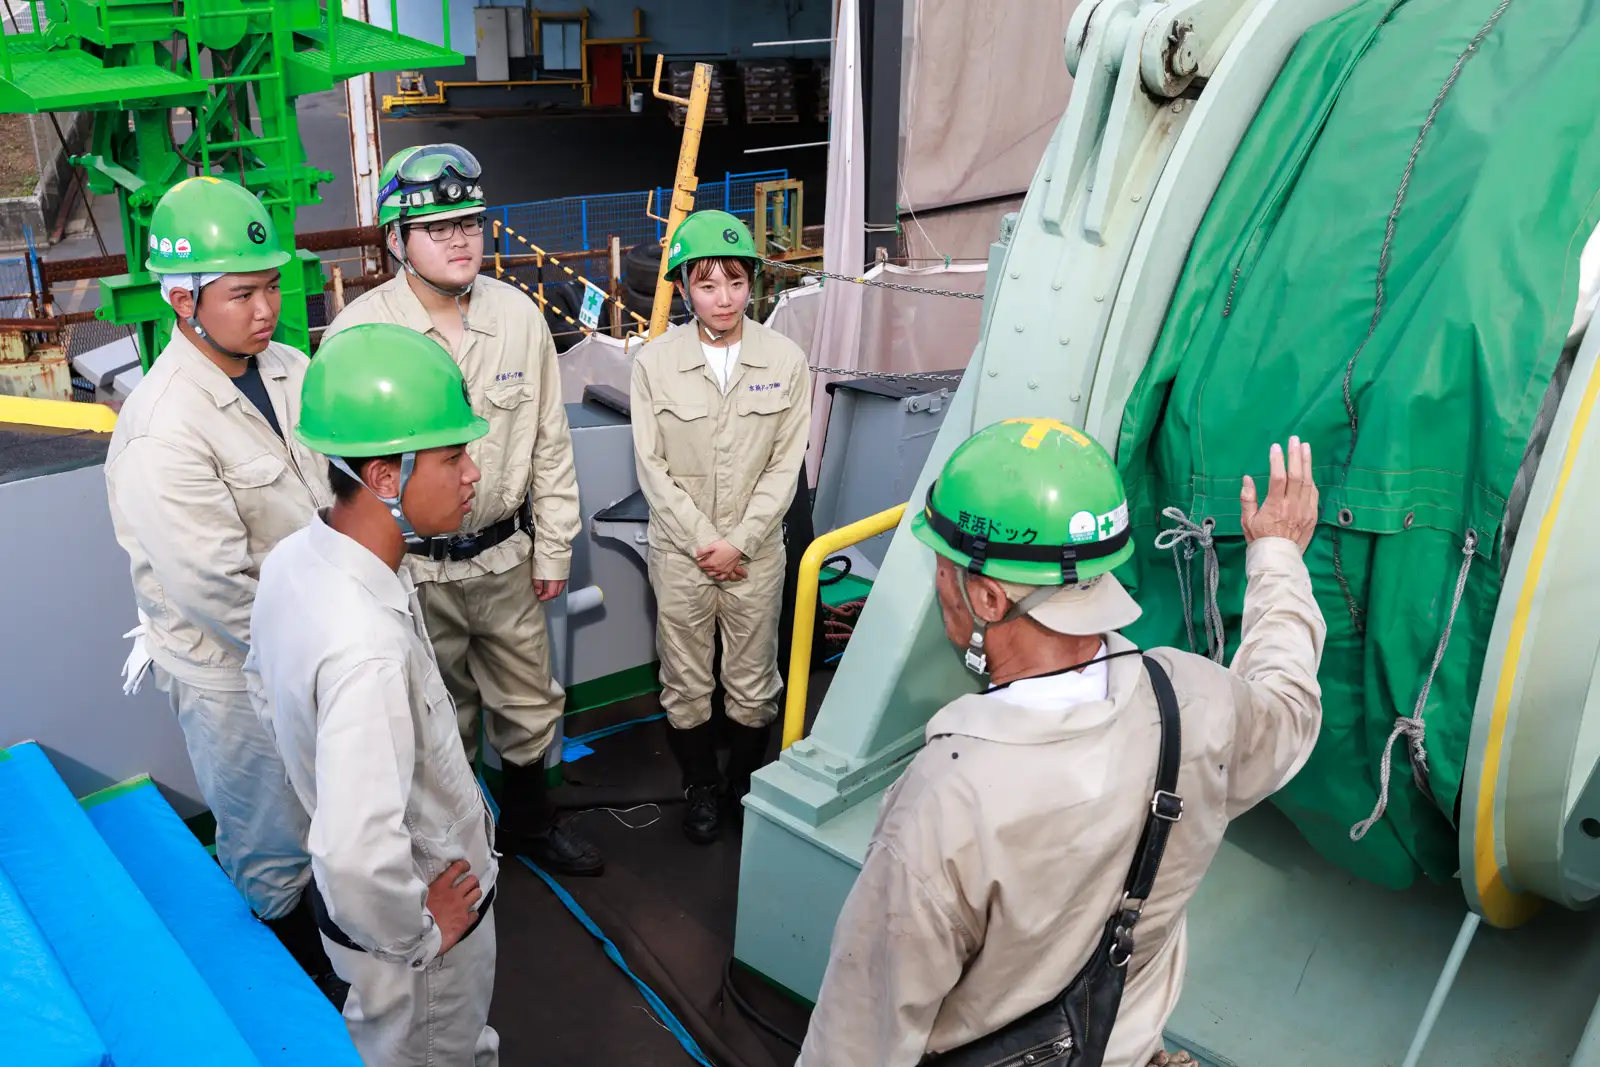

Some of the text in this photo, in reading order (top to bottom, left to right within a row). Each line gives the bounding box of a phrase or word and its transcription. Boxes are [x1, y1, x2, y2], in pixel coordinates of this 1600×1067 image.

[957, 510, 1038, 545] 京浜ドック
